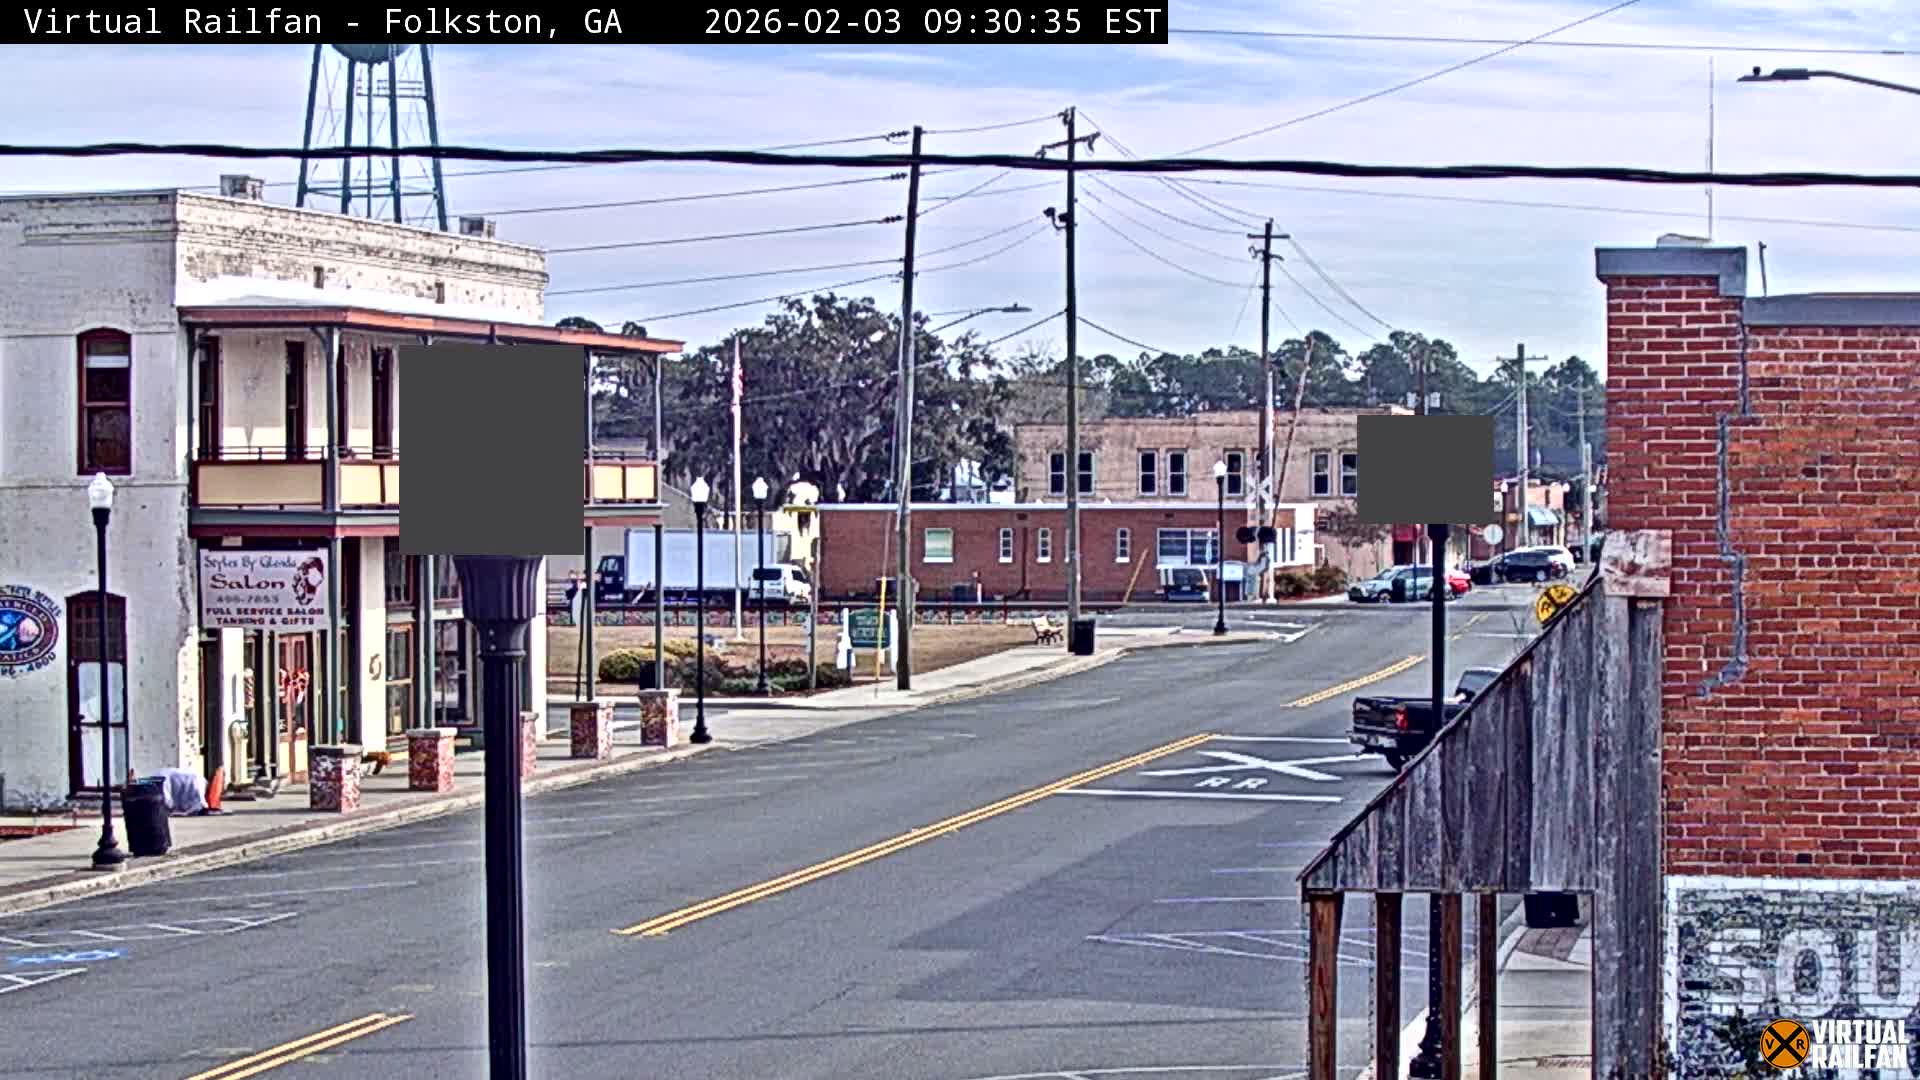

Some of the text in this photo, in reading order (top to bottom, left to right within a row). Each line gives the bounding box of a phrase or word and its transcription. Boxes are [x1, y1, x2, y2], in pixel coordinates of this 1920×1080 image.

[242, 555, 256, 572] By
[209, 573, 285, 590] Salon
[206, 607, 325, 616] FULL SERVICE SALON
[216, 617, 265, 625] TANNING
[281, 617, 315, 625] GIFTS
